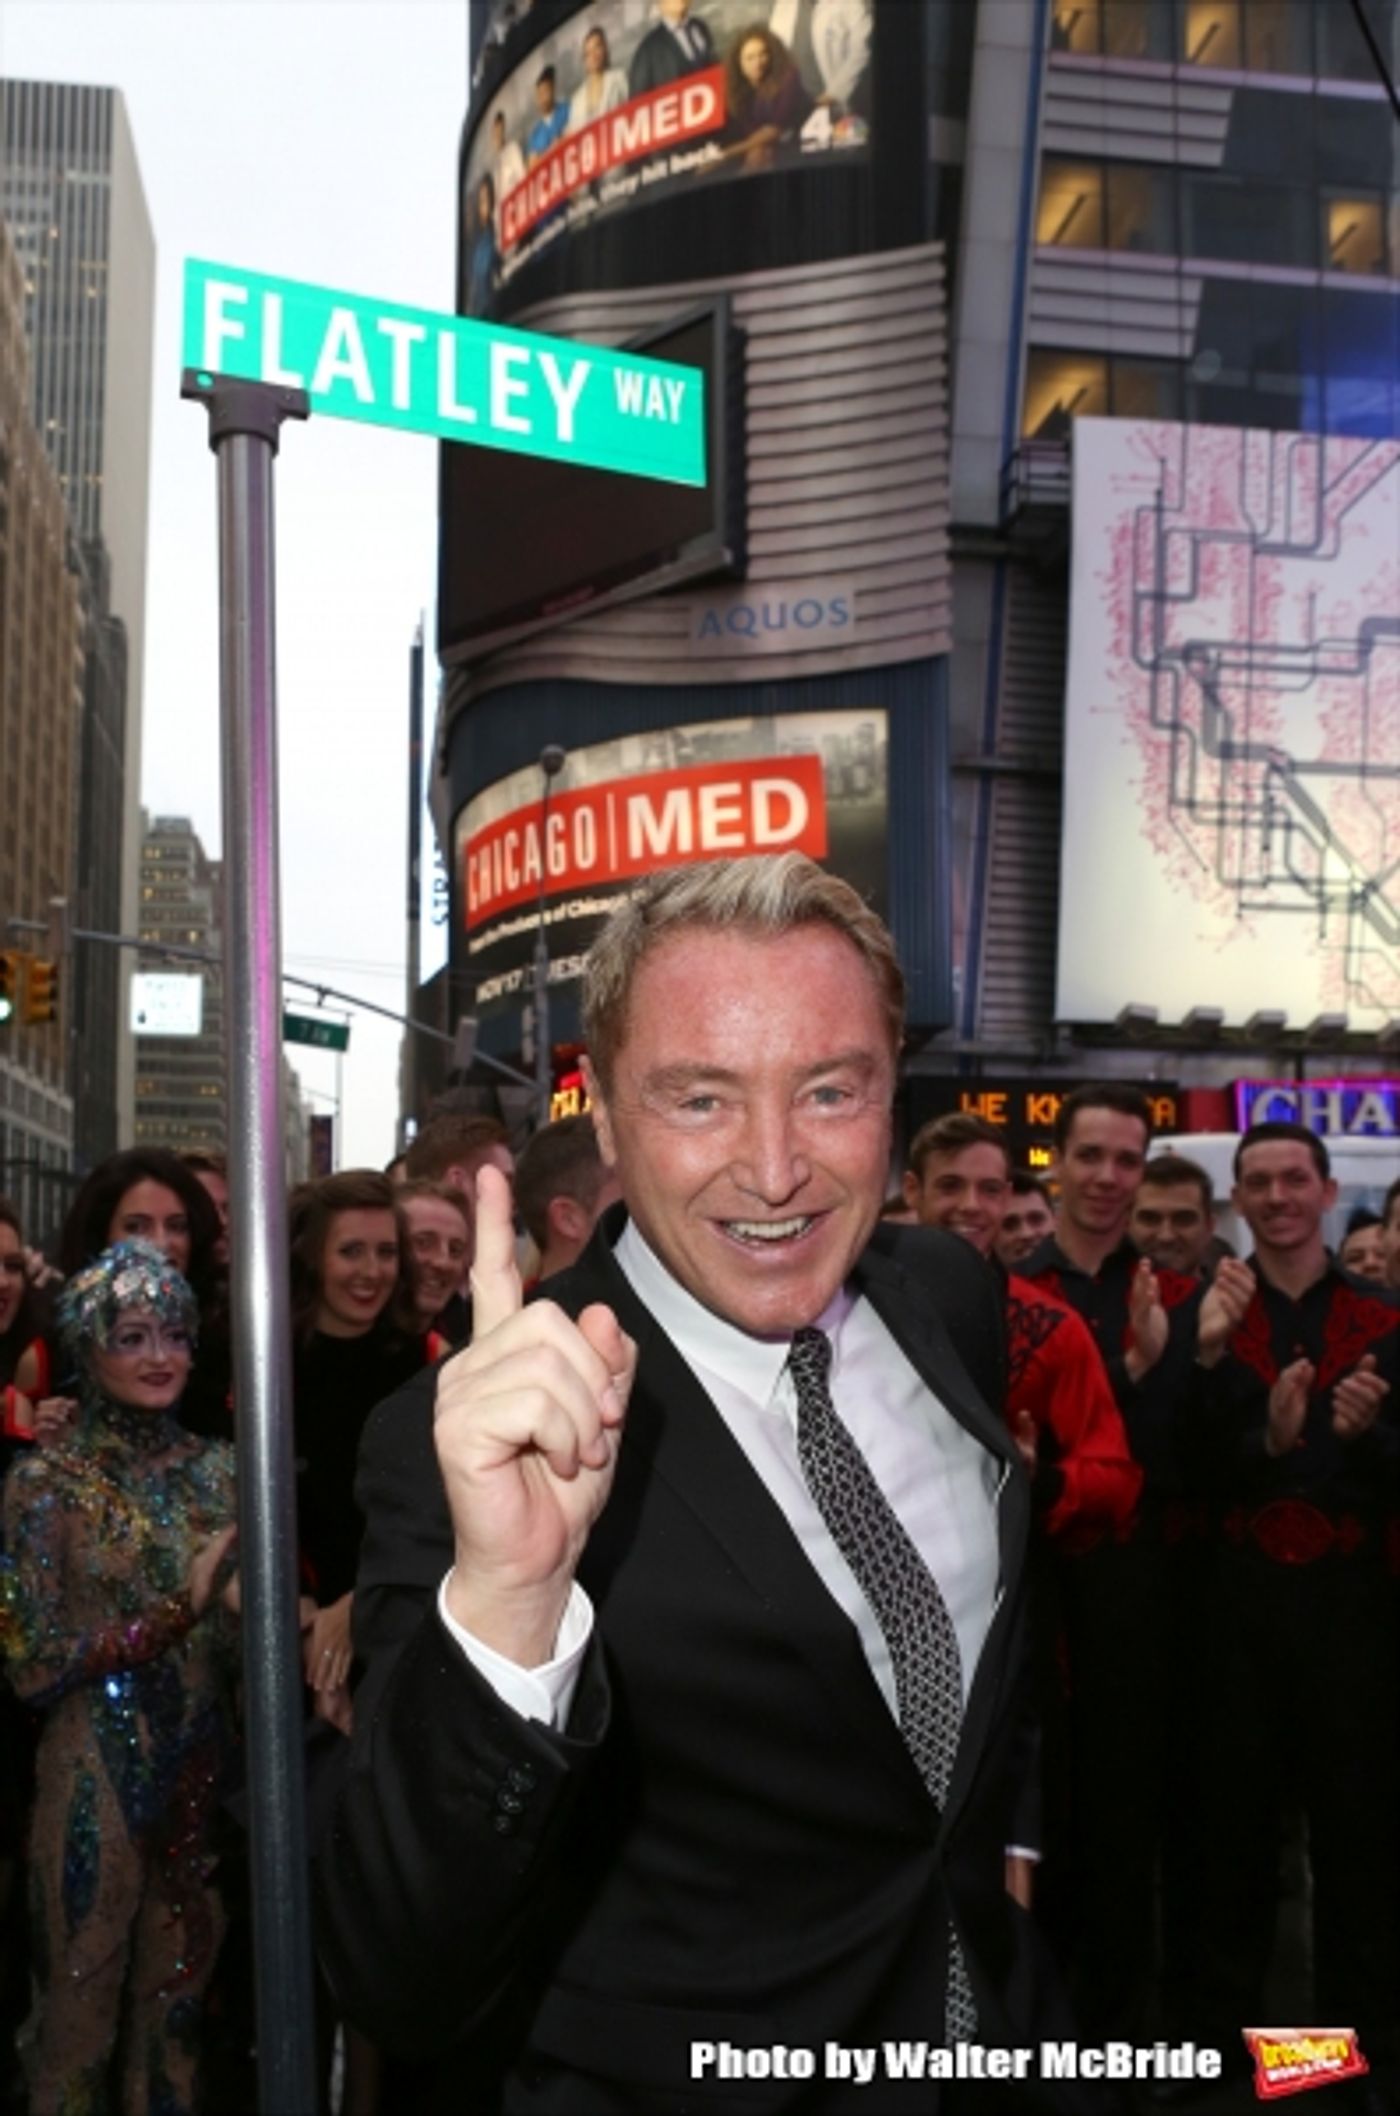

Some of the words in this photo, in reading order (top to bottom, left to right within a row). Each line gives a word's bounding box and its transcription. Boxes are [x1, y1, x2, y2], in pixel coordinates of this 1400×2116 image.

[503, 133, 597, 240] CHICAGO
[612, 83, 716, 158] MED
[800, 106, 832, 150] 4
[203, 278, 593, 443] FLATLEY
[613, 367, 686, 424] WAY
[699, 597, 851, 640] AQUOS
[469, 804, 597, 913] CHICAGO
[626, 777, 809, 861] MED
[961, 1093, 1008, 1124] WE
[1025, 1093, 1063, 1125] KN
